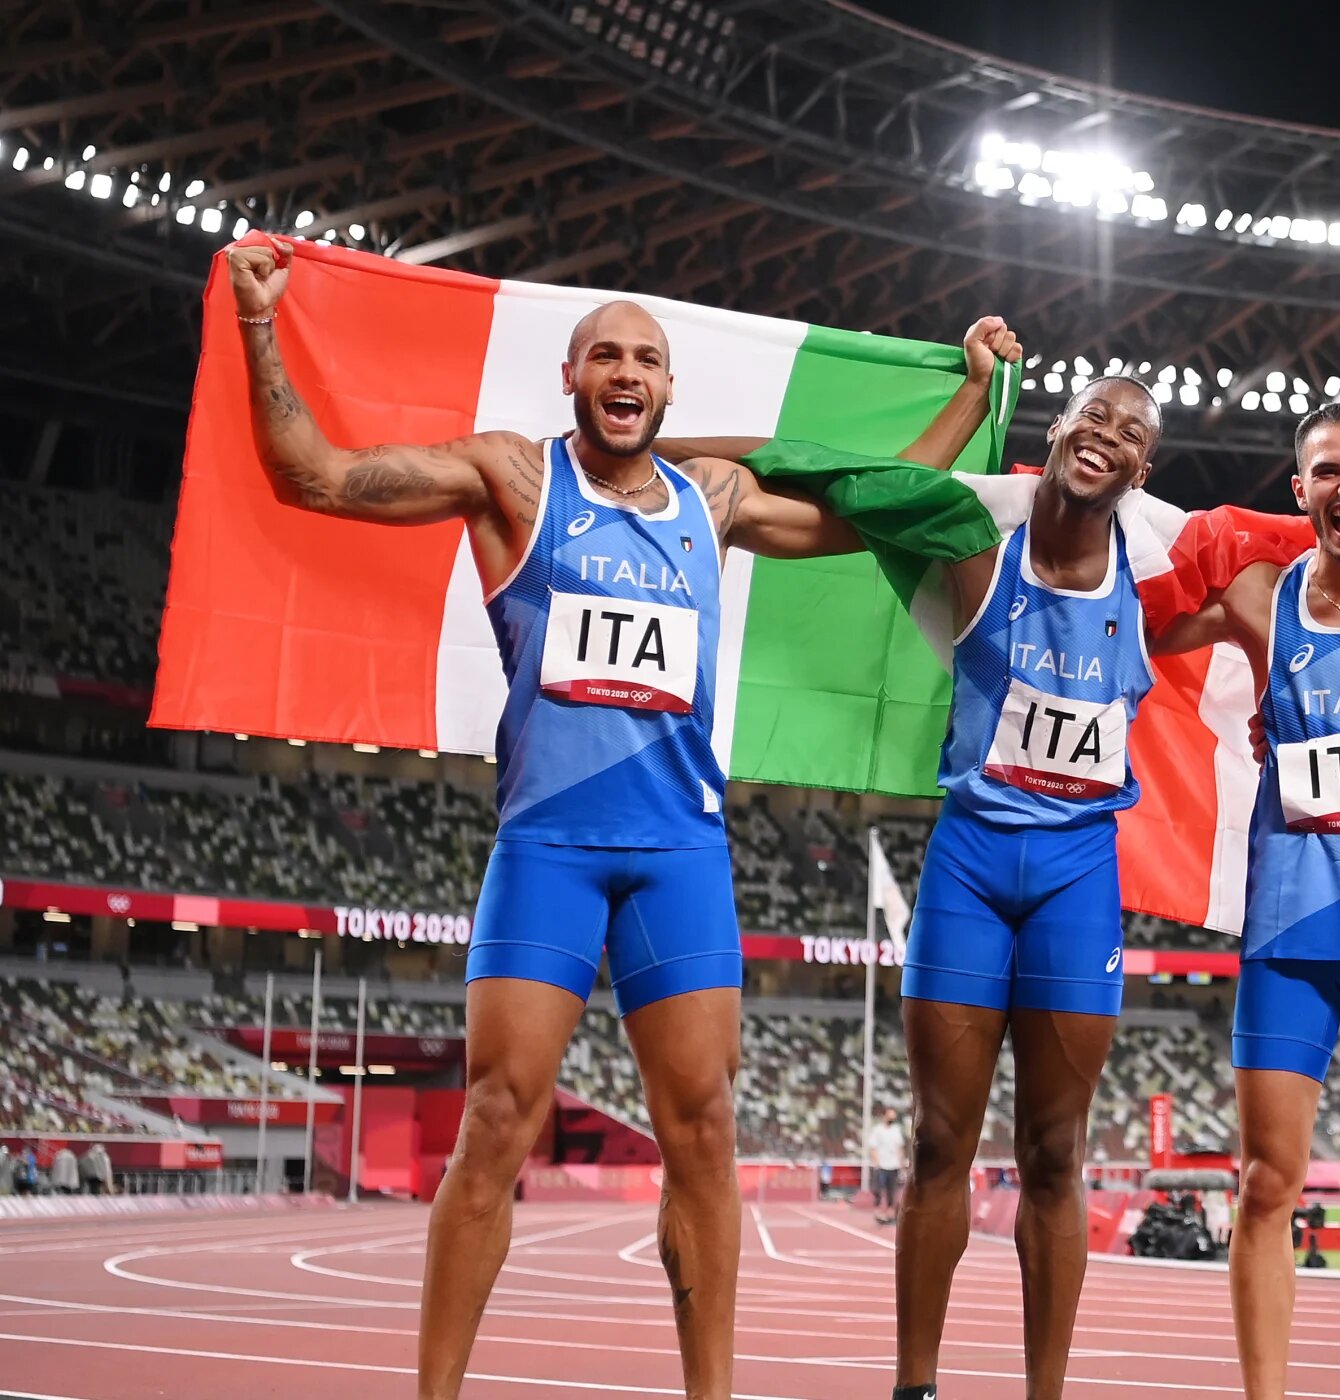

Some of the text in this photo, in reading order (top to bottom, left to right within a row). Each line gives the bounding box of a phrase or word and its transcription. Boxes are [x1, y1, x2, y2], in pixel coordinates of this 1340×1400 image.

[580, 555, 692, 596] ITALIA
[576, 608, 666, 672] ITA
[1010, 641, 1103, 682] ITALIA
[586, 686, 629, 699] TOKYO 2020
[1020, 701, 1101, 764] ITA
[1024, 775, 1064, 790] TOKYO 2020
[334, 906, 471, 945] TOKYO 2020
[800, 935, 879, 966] TOKYO
